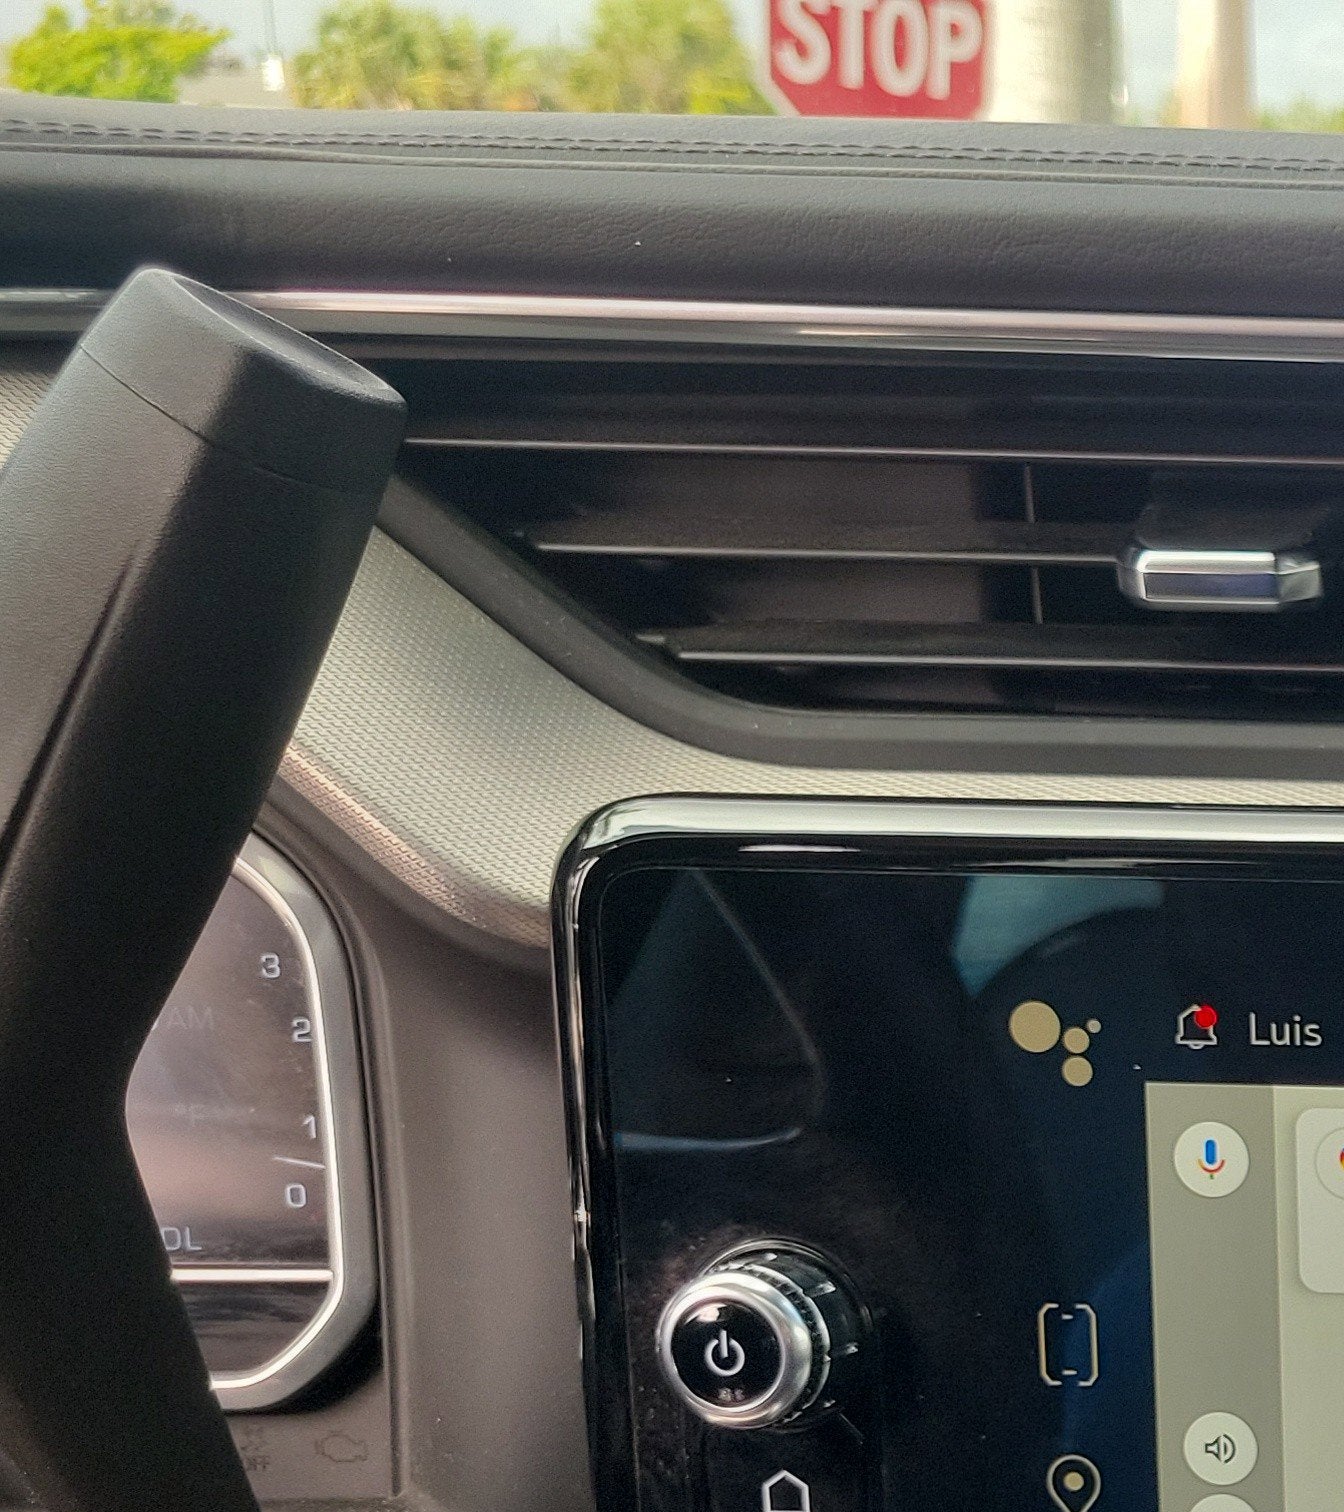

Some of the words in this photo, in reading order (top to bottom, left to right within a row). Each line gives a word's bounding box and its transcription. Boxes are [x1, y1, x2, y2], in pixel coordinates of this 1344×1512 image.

[772, 0, 984, 100] STOP
[260, 953, 281, 979] 3
[292, 1018, 312, 1043] 2
[1249, 1011, 1323, 1047] Luis
[302, 1115, 317, 1140] 1
